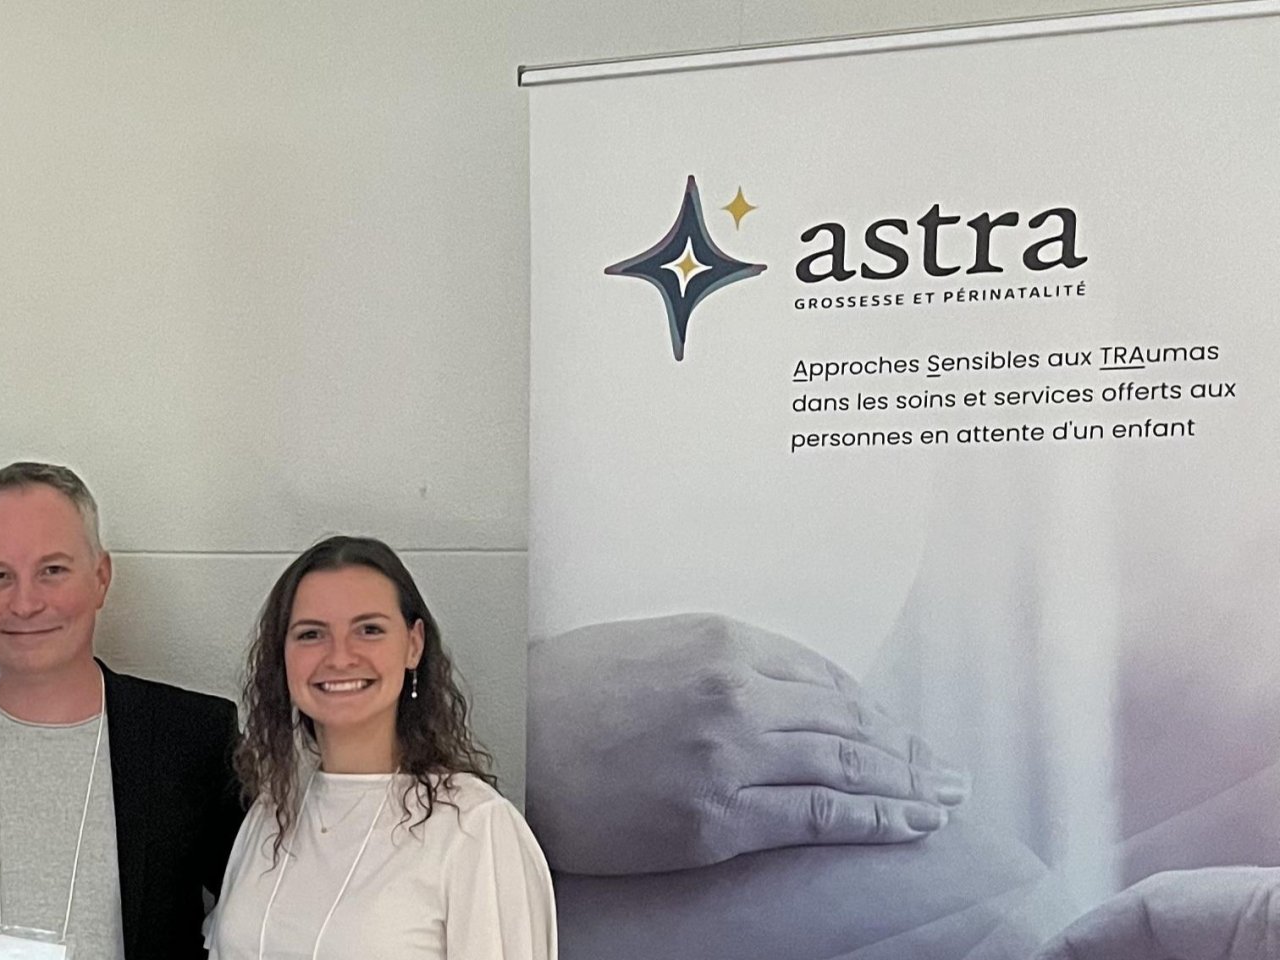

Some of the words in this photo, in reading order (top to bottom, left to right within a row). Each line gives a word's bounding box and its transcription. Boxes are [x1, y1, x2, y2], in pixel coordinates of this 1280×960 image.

[796, 204, 1088, 283] astra
[795, 294, 904, 309] GROSSESSE
[913, 292, 935, 304] ET
[944, 281, 1085, 303] PÉRINATALITÉ
[792, 356, 919, 382] Approches
[926, 351, 1039, 378] Sensibles
[1048, 351, 1091, 367] aux
[1099, 346, 1219, 370] TRAumas
[793, 394, 849, 412] dans
[858, 393, 888, 410] les
[896, 390, 955, 409] soins
[964, 390, 986, 407] et
[994, 386, 1093, 405] services
[1102, 382, 1181, 402] offerts
[1191, 383, 1236, 398] aux
[792, 431, 912, 453] personnes
[921, 430, 948, 444] en
[957, 425, 1044, 443] attente
[1053, 421, 1103, 440] d'un
[1113, 419, 1195, 438] enfant
